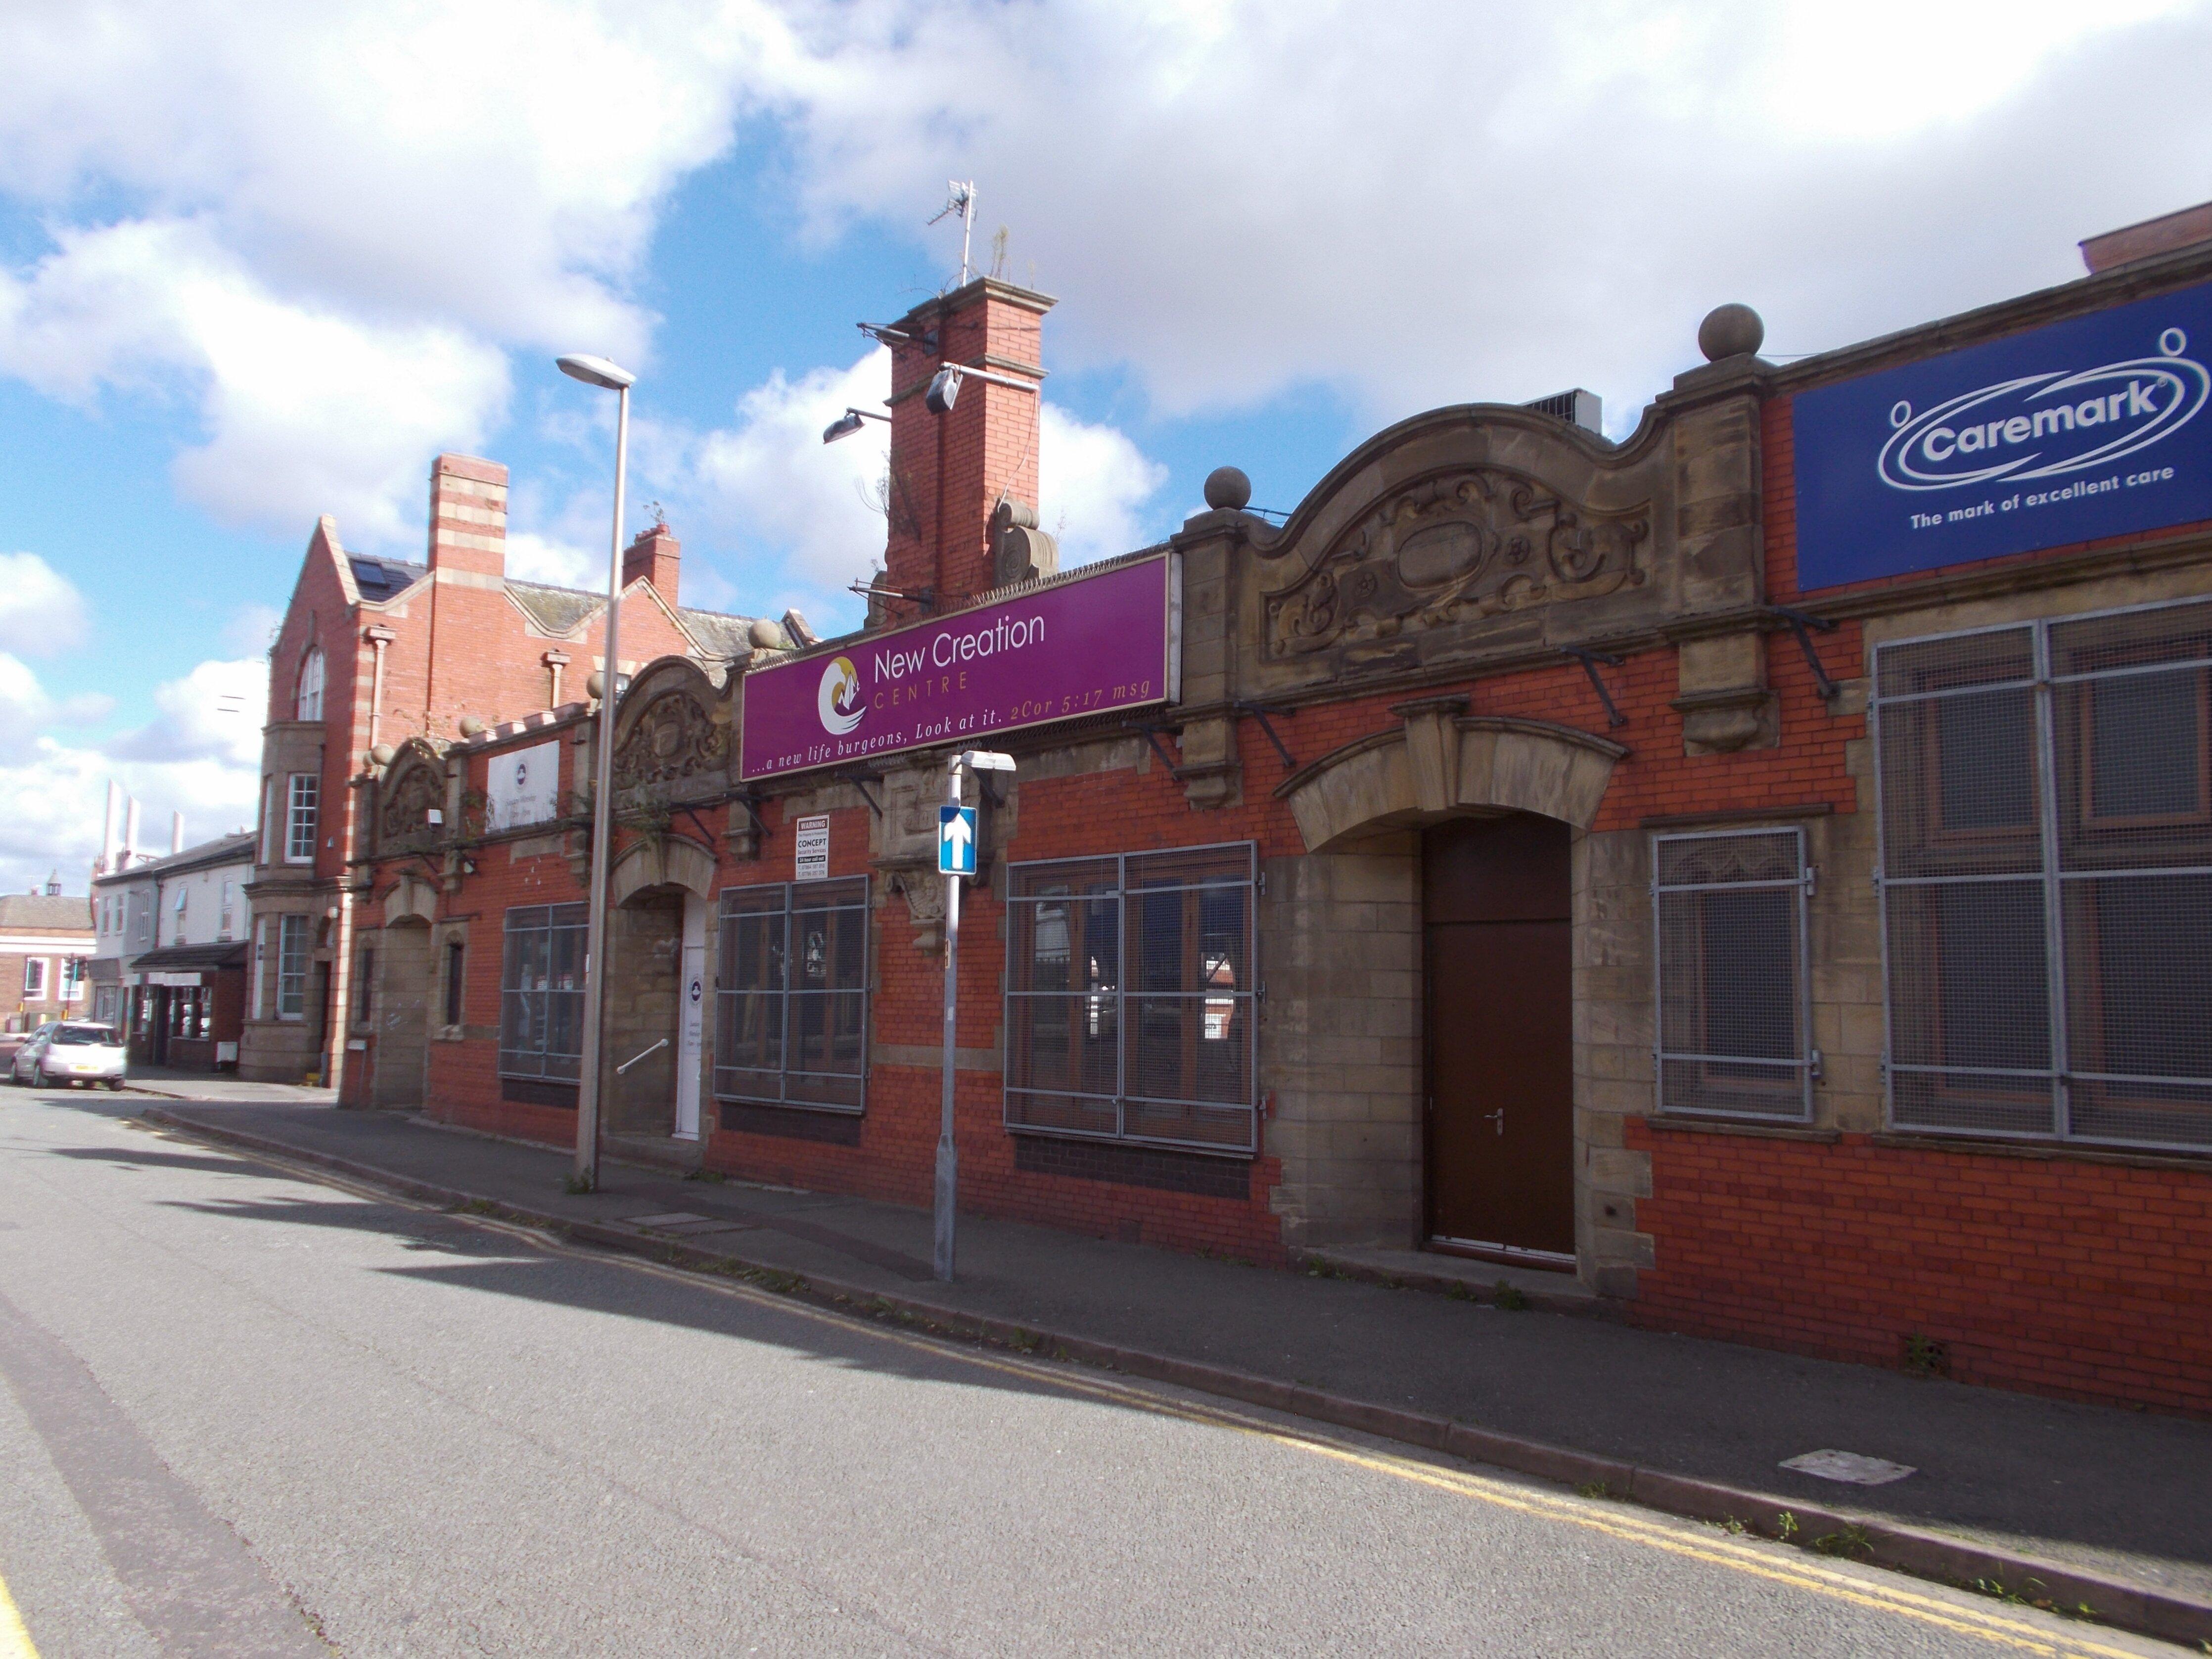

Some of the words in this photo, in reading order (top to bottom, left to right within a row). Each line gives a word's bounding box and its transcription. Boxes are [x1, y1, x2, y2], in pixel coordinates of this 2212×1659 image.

[1923, 380, 2158, 461] Caremark
[1910, 513, 1942, 529] The
[1948, 501, 1994, 521] mark
[2001, 494, 2019, 511] of
[2026, 476, 2119, 506] excellent
[2126, 467, 2173, 486] care
[875, 646, 926, 684] New
[932, 615, 1044, 667] Creation
[875, 671, 968, 709] CENTRE
[779, 753, 802, 767] new
[808, 743, 830, 763] life
[837, 732, 907, 756] burgeons,
[915, 716, 951, 739] Look
[959, 714, 974, 730] at
[983, 709, 1002, 726] it.
[1011, 699, 1053, 720] 2Cor
[1062, 689, 1103, 713] 5:17
[1113, 681, 1150, 699] msg
[798, 838, 827, 848] CONCEPT
[801, 820, 826, 830] WARNING
